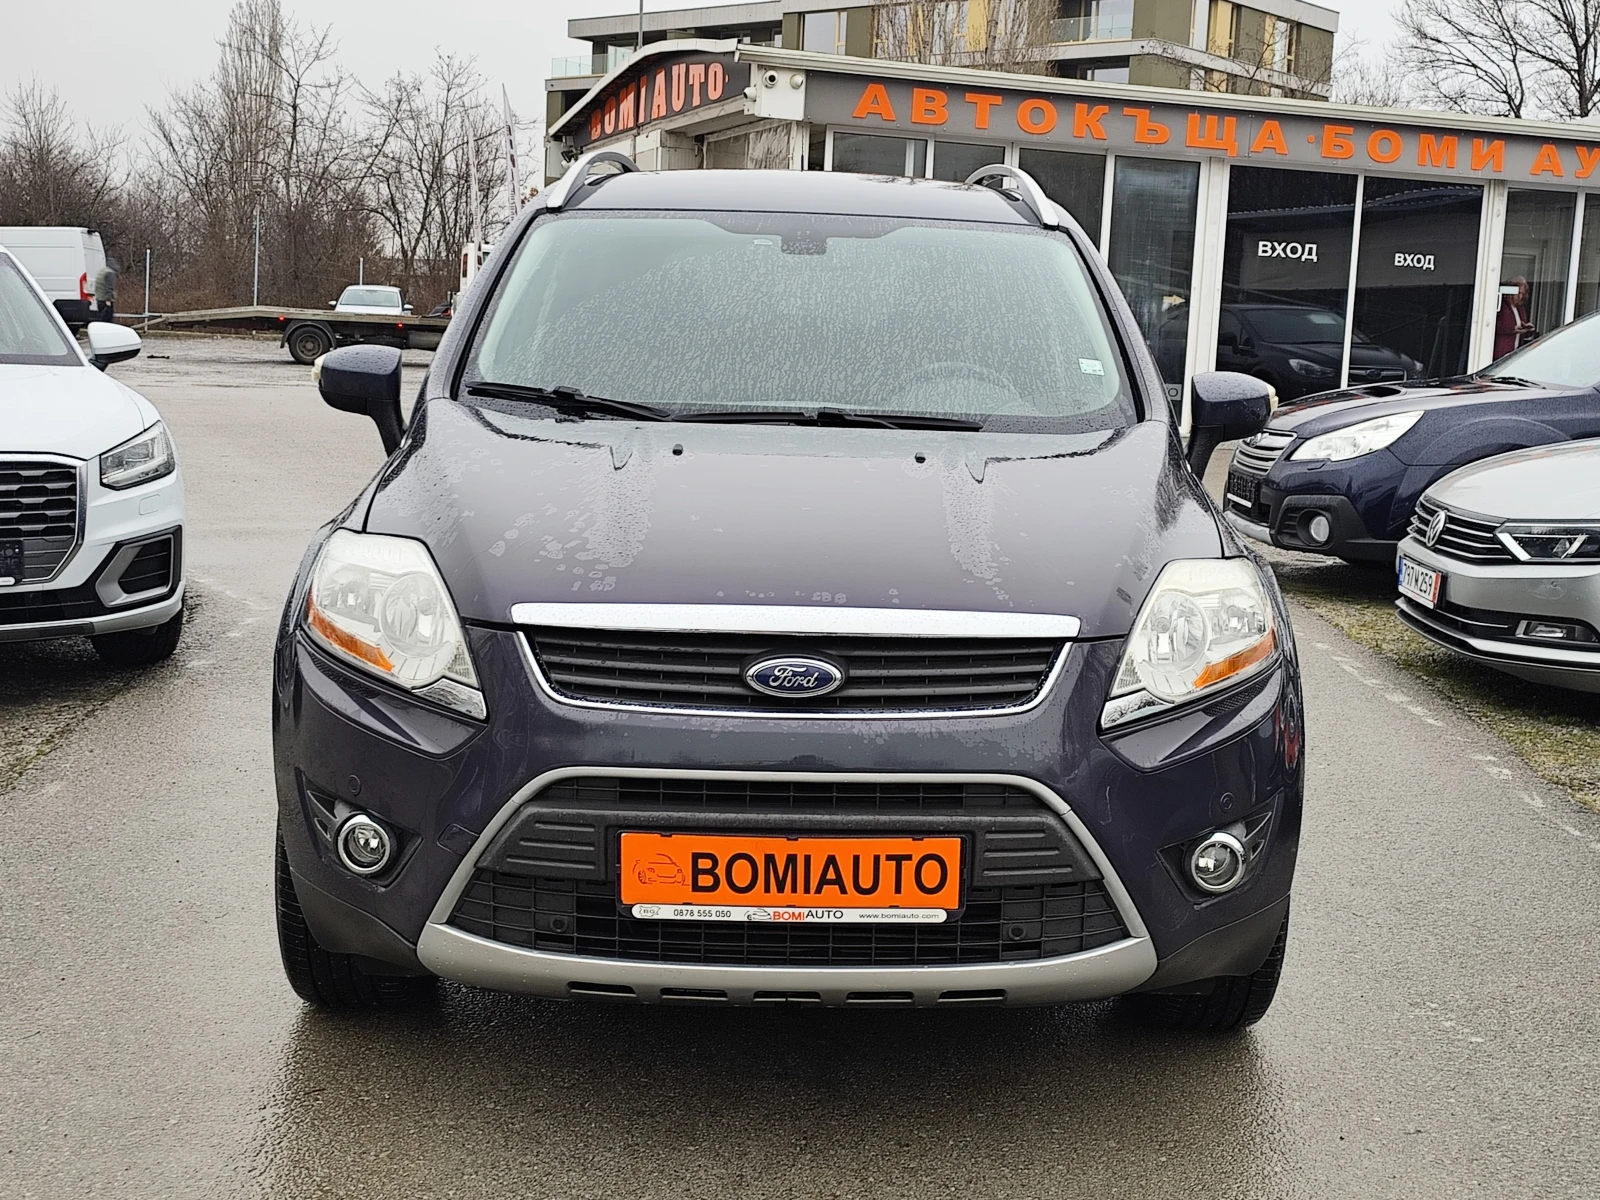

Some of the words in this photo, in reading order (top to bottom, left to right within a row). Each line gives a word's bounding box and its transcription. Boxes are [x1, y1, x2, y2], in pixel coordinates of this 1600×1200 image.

[590, 62, 724, 140] BOMIAUTO
[852, 83, 1289, 157] АВТОКЪЩА
[1257, 240, 1318, 263] ВХОД
[1394, 253, 1435, 271] ВХОД
[768, 665, 820, 688] Ford
[690, 851, 948, 896] BOMIAUTO
[673, 908, 695, 917] 0878
[697, 909, 713, 918] 555
[715, 909, 732, 918] 050
[772, 909, 844, 921] BOMIAUTO
